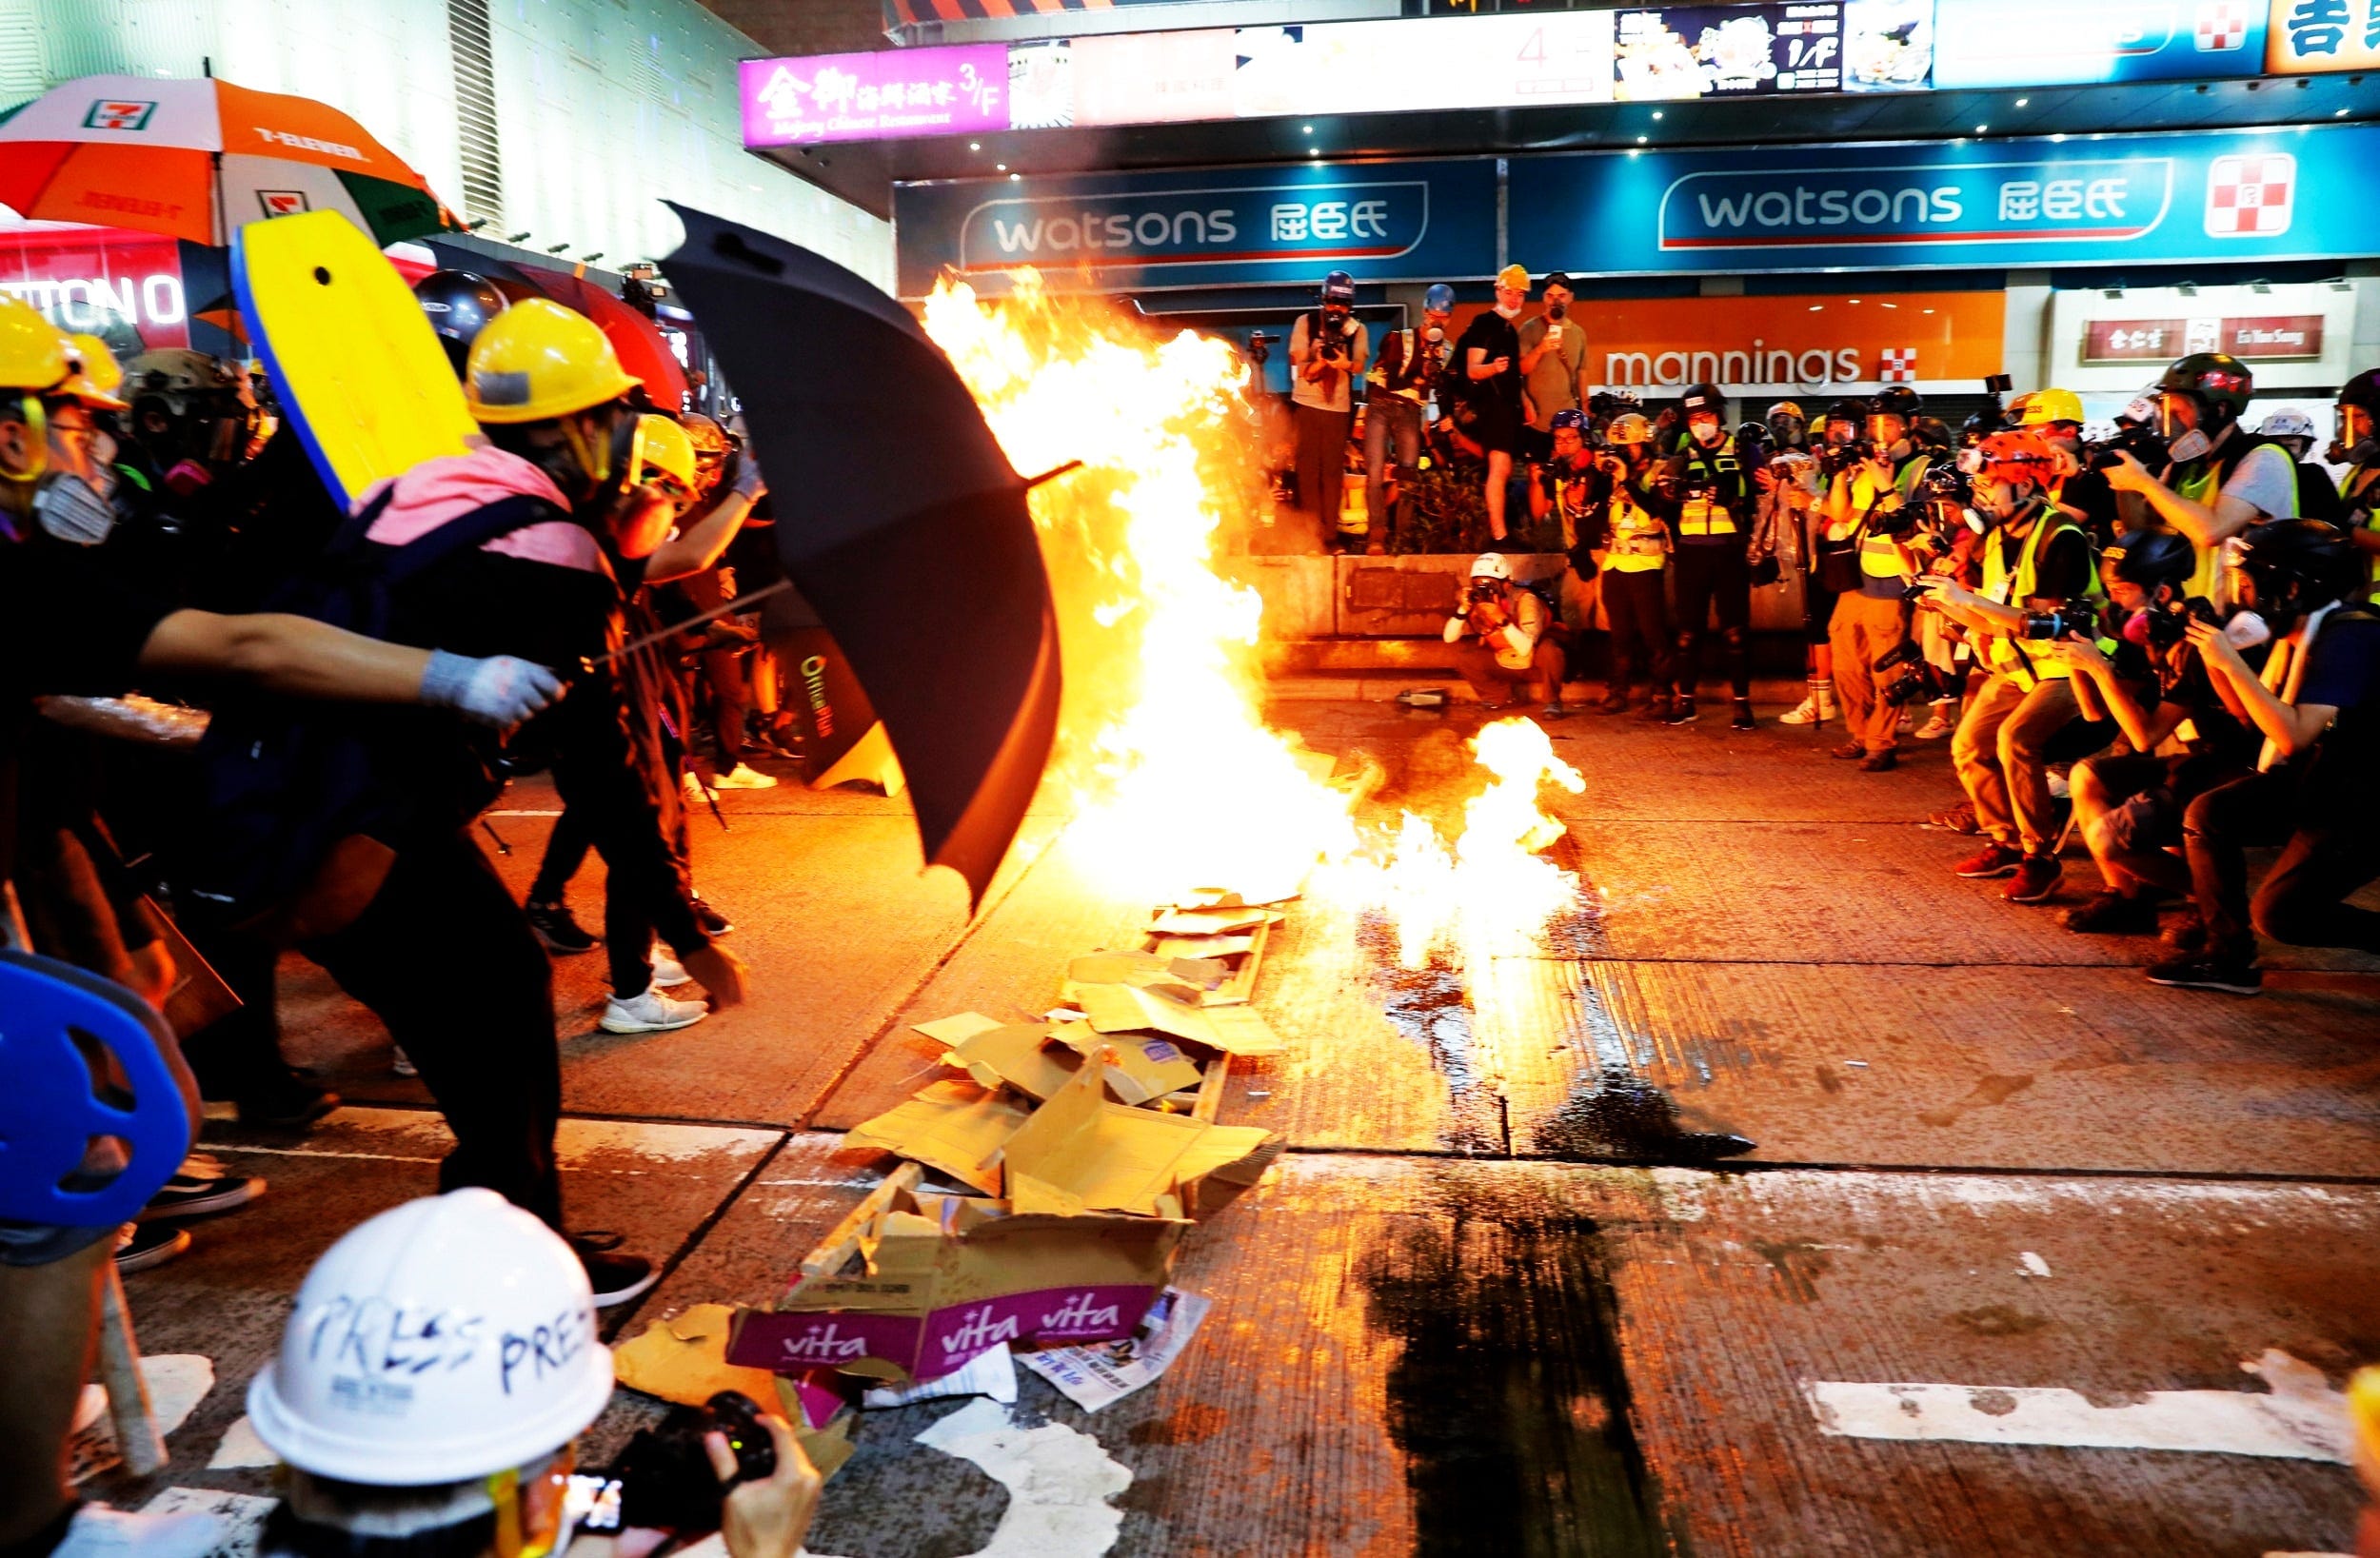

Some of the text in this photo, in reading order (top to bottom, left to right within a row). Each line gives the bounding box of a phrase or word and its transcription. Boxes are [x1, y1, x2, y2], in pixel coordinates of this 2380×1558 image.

[1271, 200, 1388, 241] 屈臣氏
[1698, 186, 1963, 227] watsons
[1999, 178, 2128, 221] 屈臣氏
[993, 208, 1238, 252] watsons
[1606, 339, 1860, 395] mannings
[942, 1305, 1019, 1353] vita
[1041, 1292, 1120, 1328] vita
[783, 1324, 867, 1356] vita
